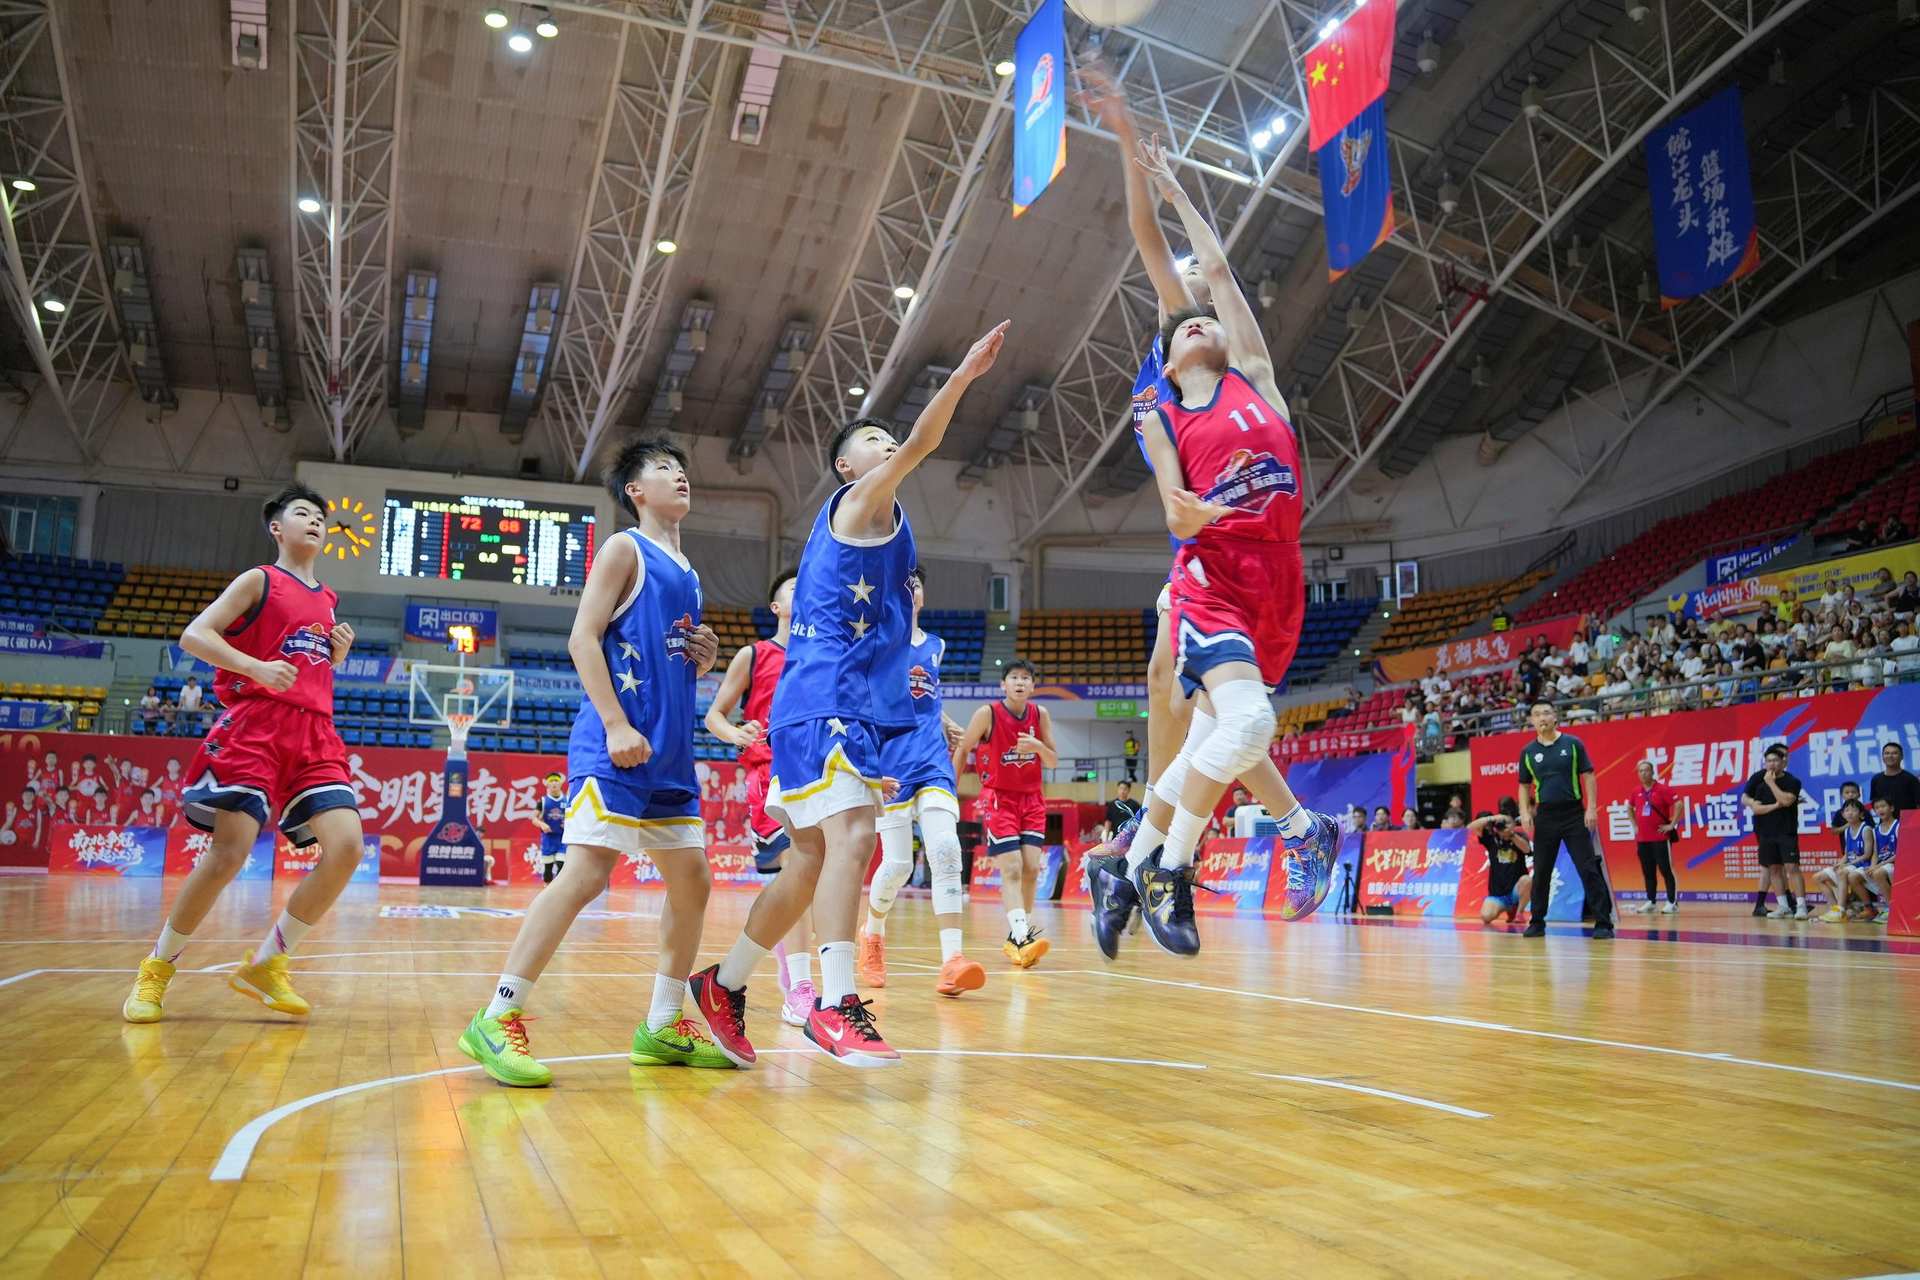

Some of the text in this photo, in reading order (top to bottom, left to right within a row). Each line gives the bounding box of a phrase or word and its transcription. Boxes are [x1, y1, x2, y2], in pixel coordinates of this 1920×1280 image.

[1228, 401, 1269, 432] 11
[460, 516, 521, 533] 72 68
[1693, 583, 1744, 614] Happy
[1744, 576, 1779, 599] Run
